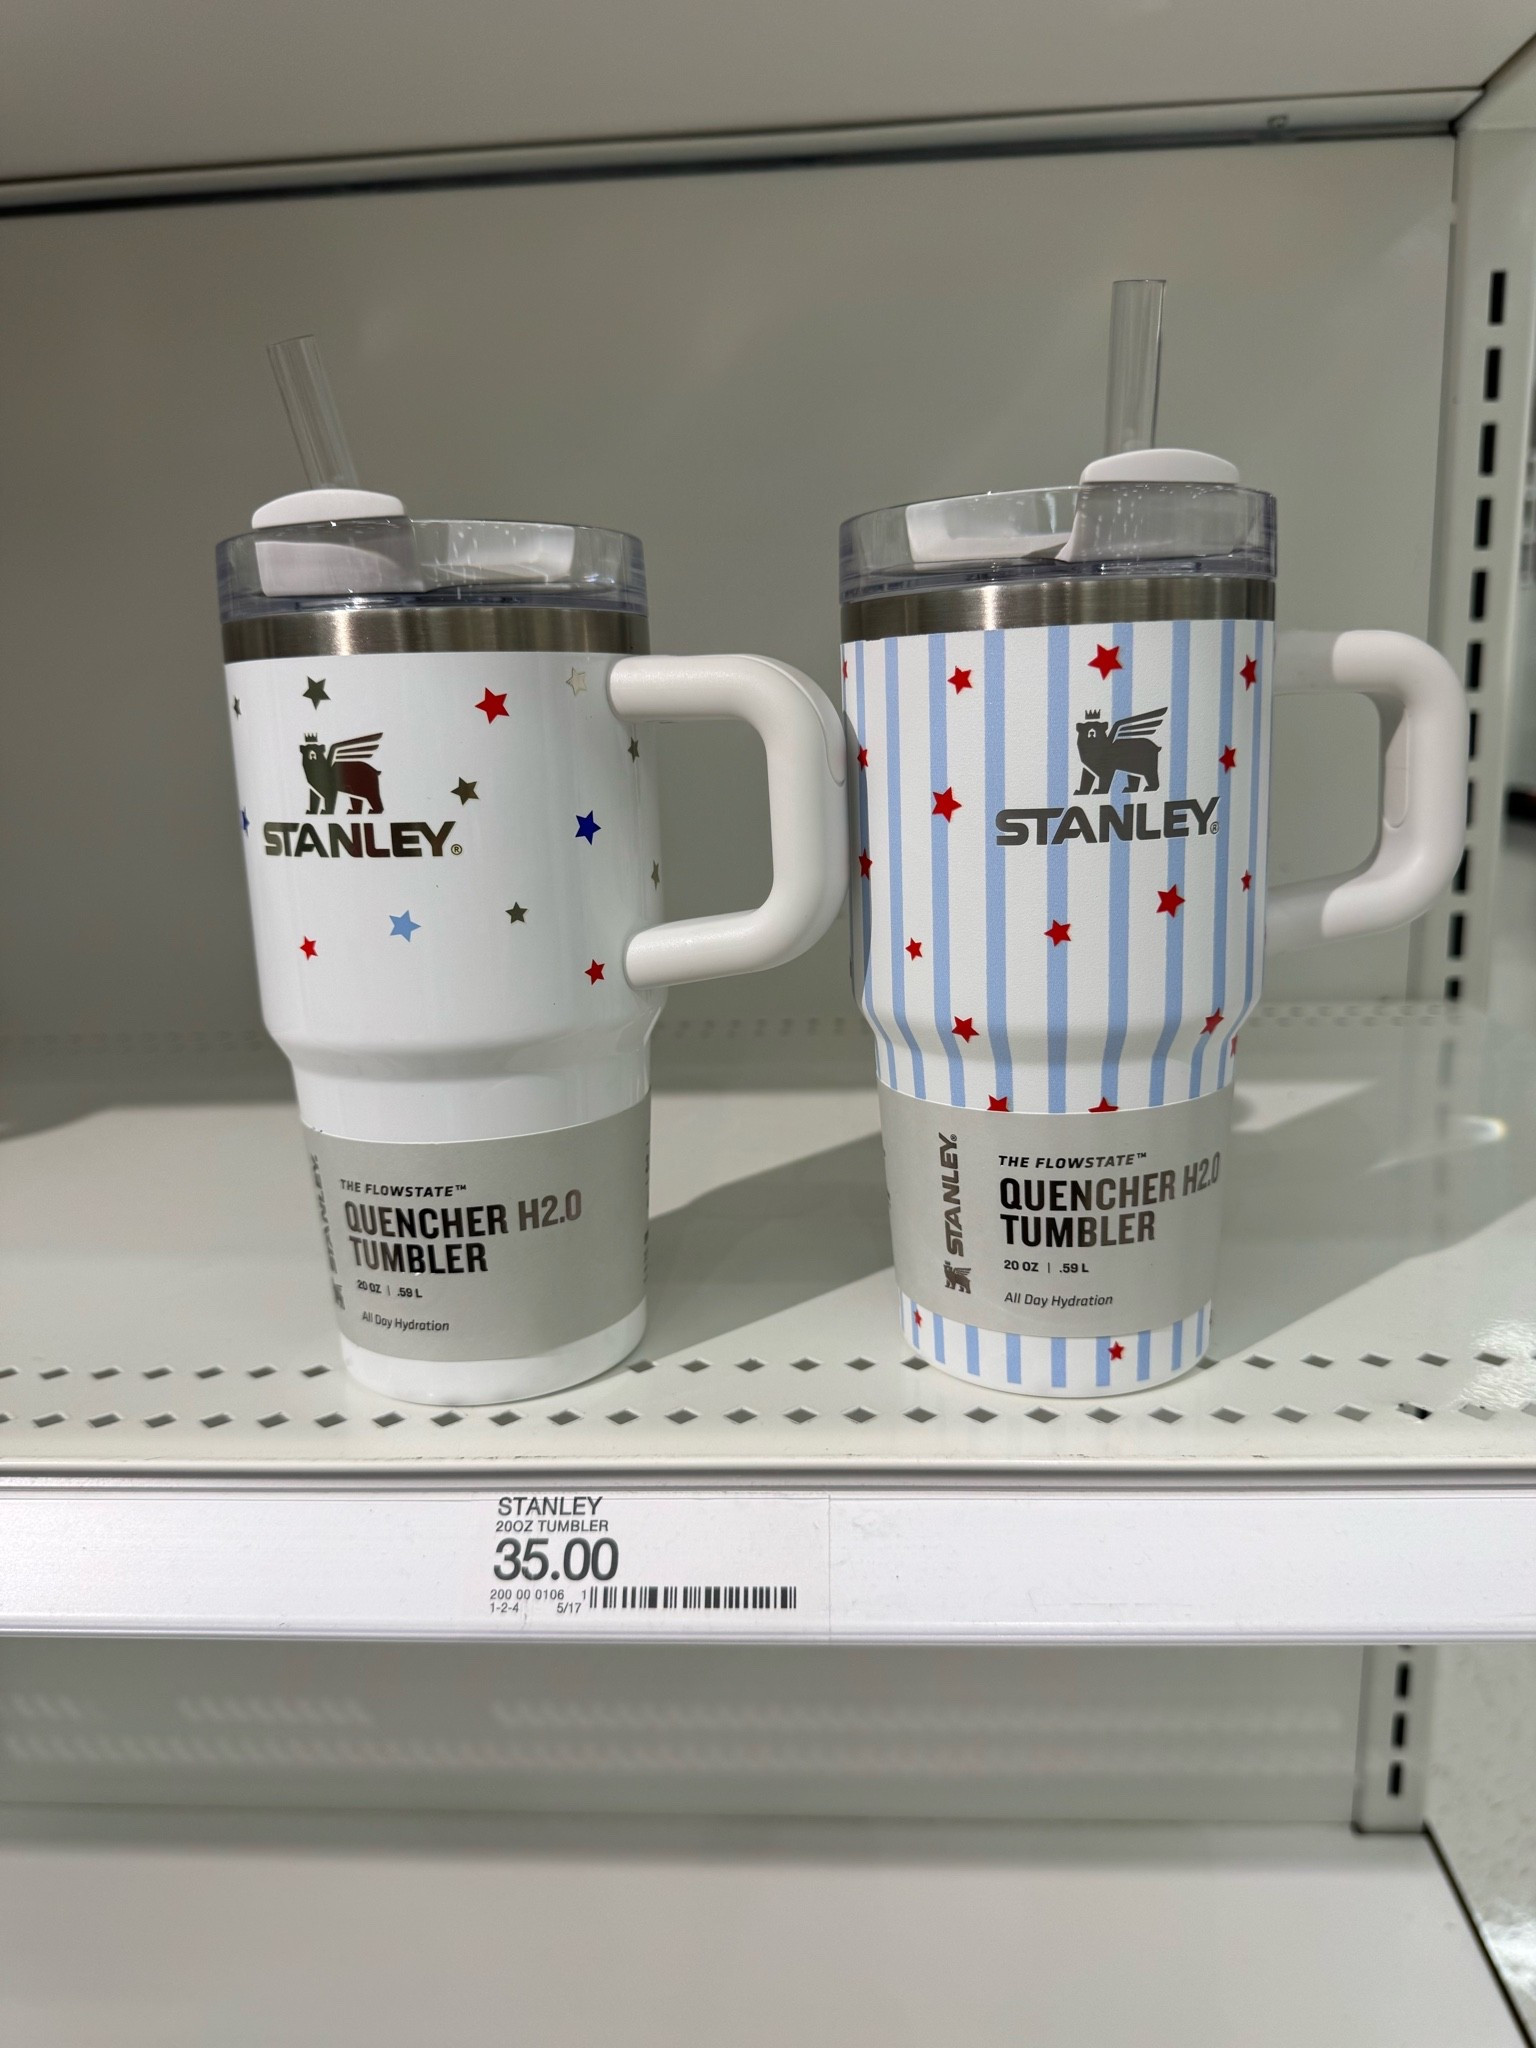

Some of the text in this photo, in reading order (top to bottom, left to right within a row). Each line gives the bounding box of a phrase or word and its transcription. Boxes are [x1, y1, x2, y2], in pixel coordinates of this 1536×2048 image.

[999, 1155, 1030, 1168] THE
[340, 1179, 361, 1192] THE
[1000, 1151, 1221, 1211] QUENCHER H2.0
[344, 1189, 582, 1239] QUENCHER H2.0
[1000, 1210, 1155, 1248] TUMBLER
[349, 1236, 488, 1274] TUMBLER
[1003, 1260, 1089, 1273] 20 OZ .59 L
[357, 1279, 423, 1298] 20 OZ .59 L
[1004, 1292, 1113, 1309] All Day Hydration
[362, 1311, 450, 1332] All Day Hydration
[498, 1496, 603, 1516] STANLEY
[495, 1520, 609, 1533] 20OZ TUMBLER
[493, 1537, 619, 1581] 35.00
[490, 1588, 512, 1600] 200
[516, 1588, 531, 1600] 00
[535, 1588, 565, 1600] 0106
[490, 1602, 582, 1613] 1-2-4 5/17
